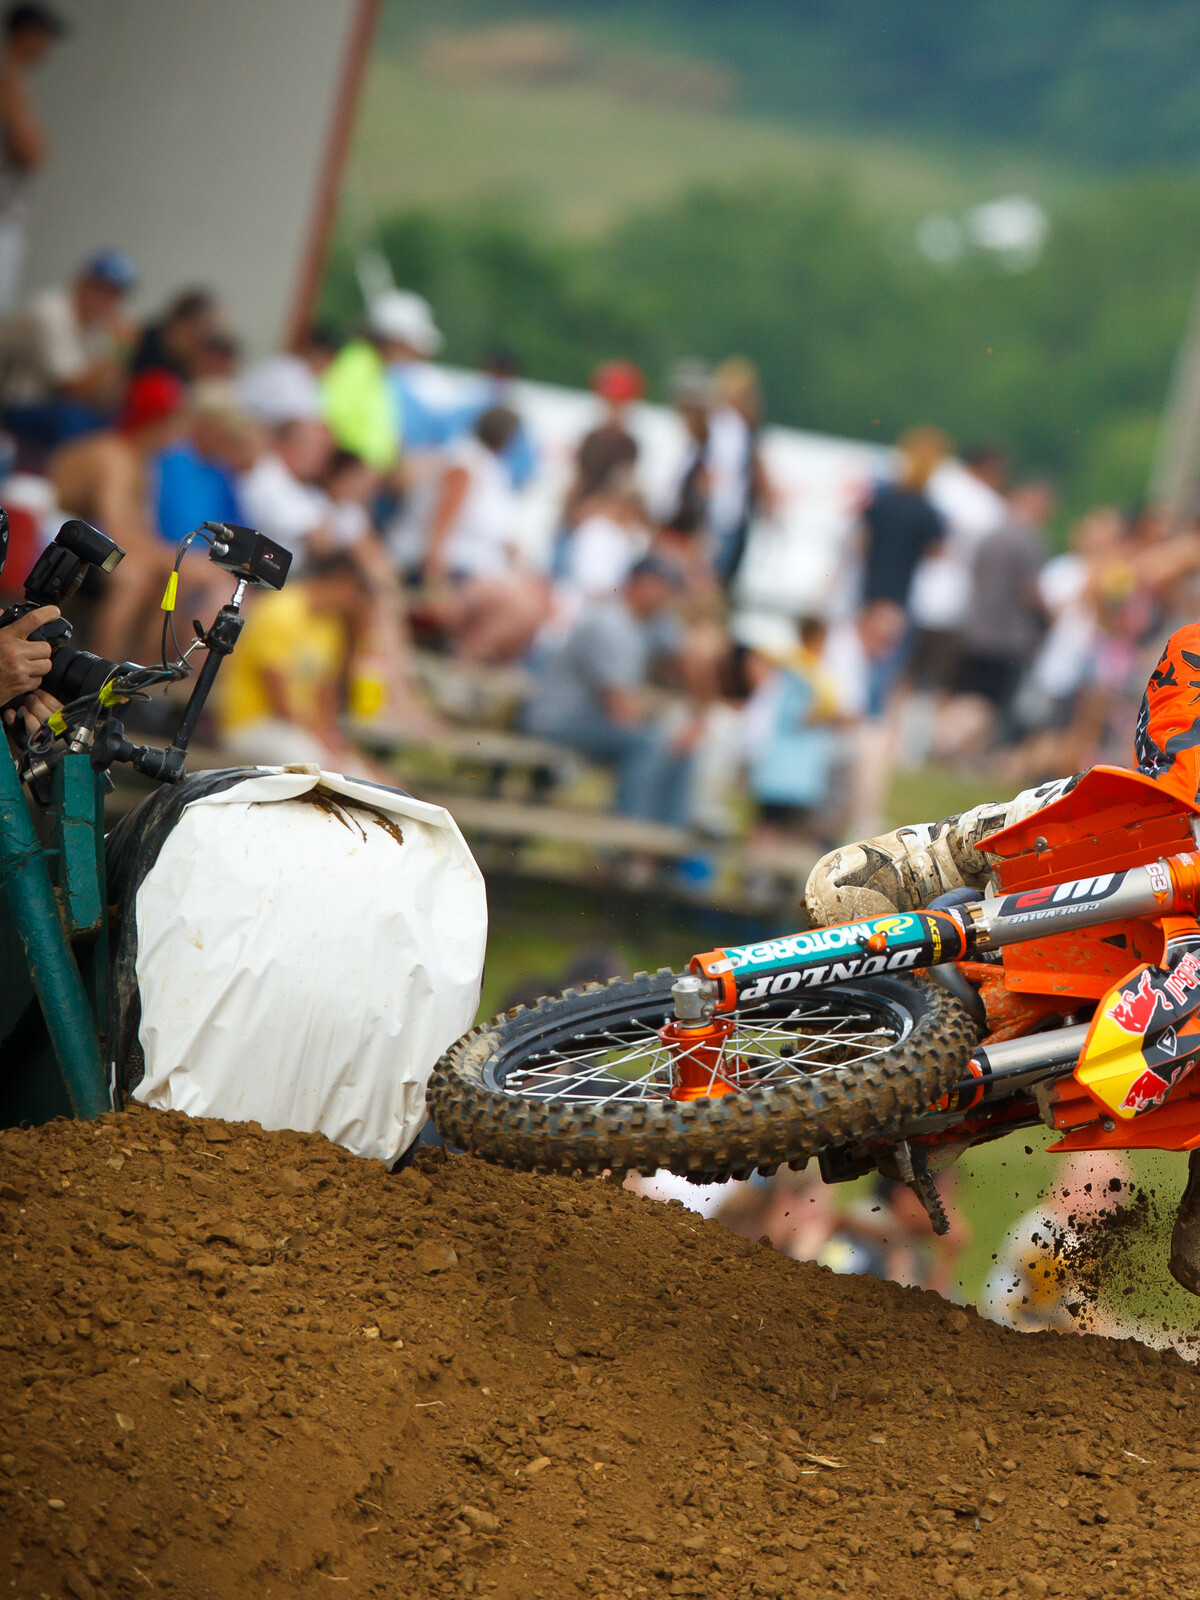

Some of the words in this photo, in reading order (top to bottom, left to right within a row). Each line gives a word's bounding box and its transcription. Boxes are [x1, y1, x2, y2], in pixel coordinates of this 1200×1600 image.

[1009, 909, 1057, 924] VALVE
[1057, 902, 1101, 916] CONE
[731, 922, 874, 967] MOTOREX
[739, 947, 924, 1001] DUNLOP
